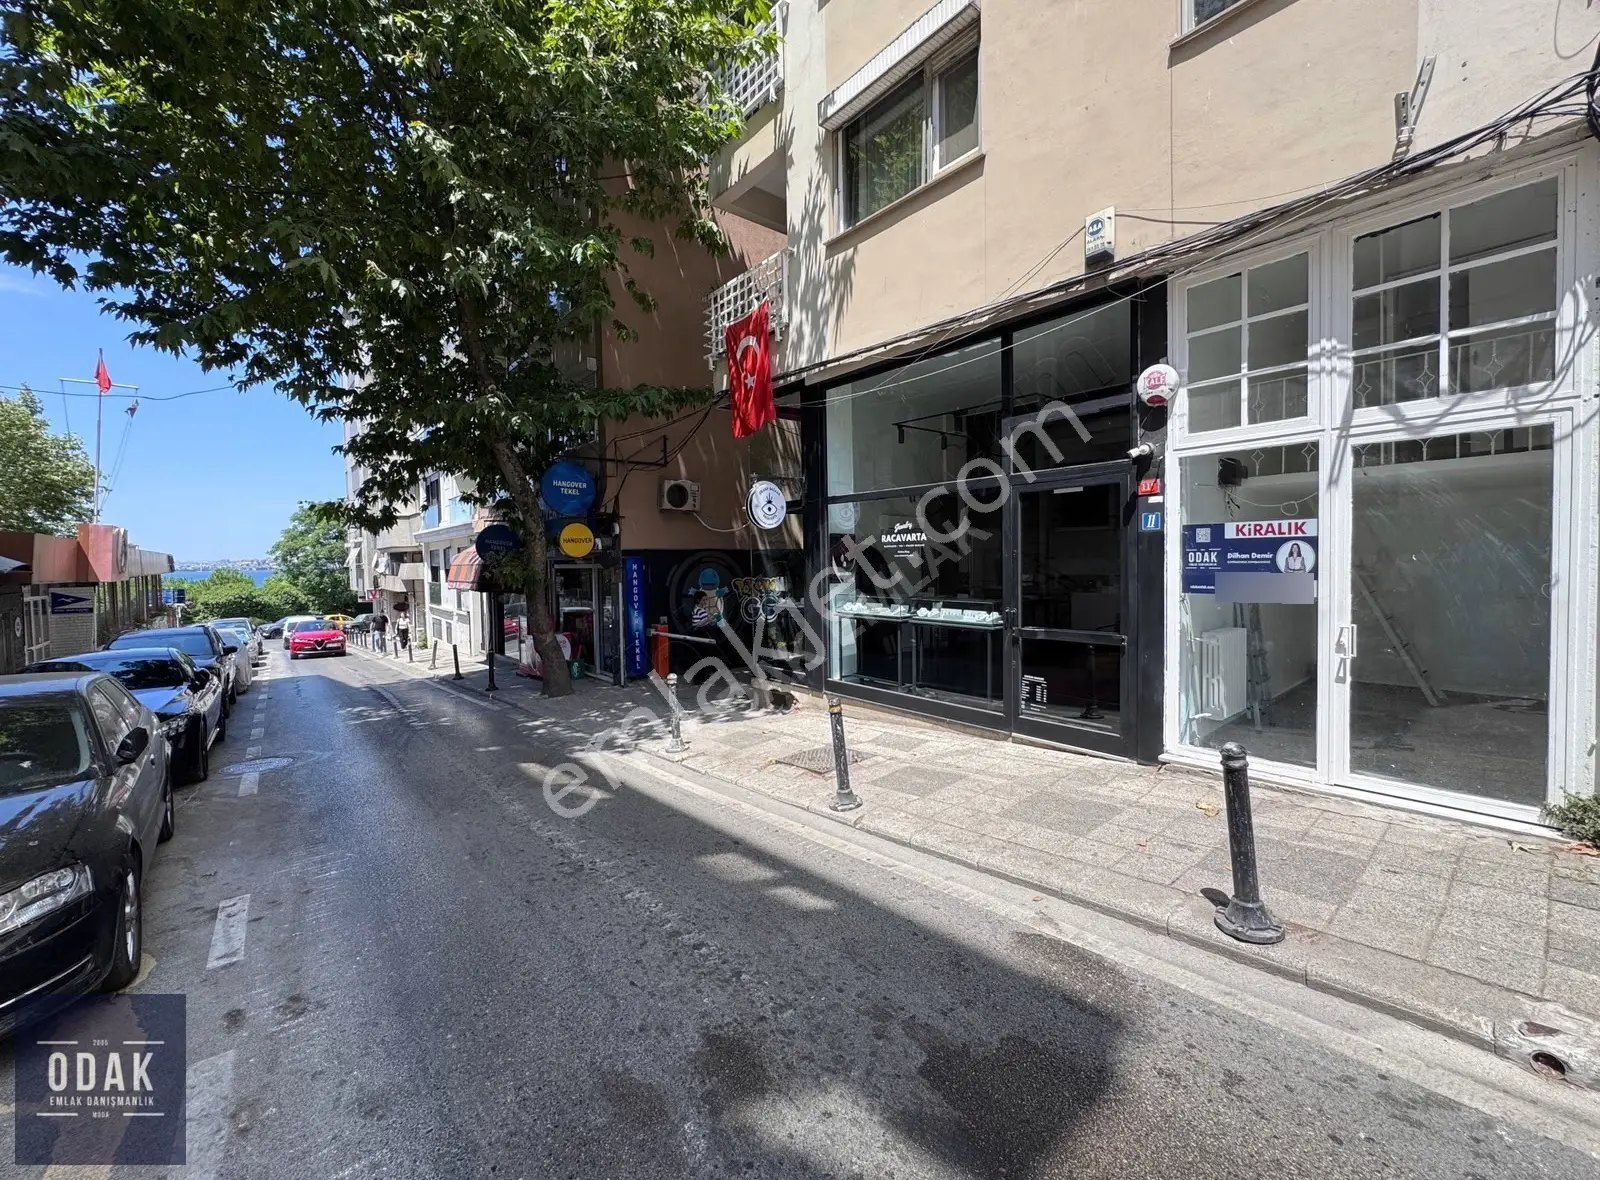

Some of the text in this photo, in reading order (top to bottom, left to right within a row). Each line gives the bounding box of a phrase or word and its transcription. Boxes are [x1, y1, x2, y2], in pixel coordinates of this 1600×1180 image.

[552, 480, 587, 488] HANGOVER
[561, 487, 580, 496] TEKEL
[1147, 514, 1156, 528] 11
[881, 532, 927, 542] RACAVARTA
[1188, 552, 1218, 563] ODAK
[632, 563, 640, 625] HANGOVER
